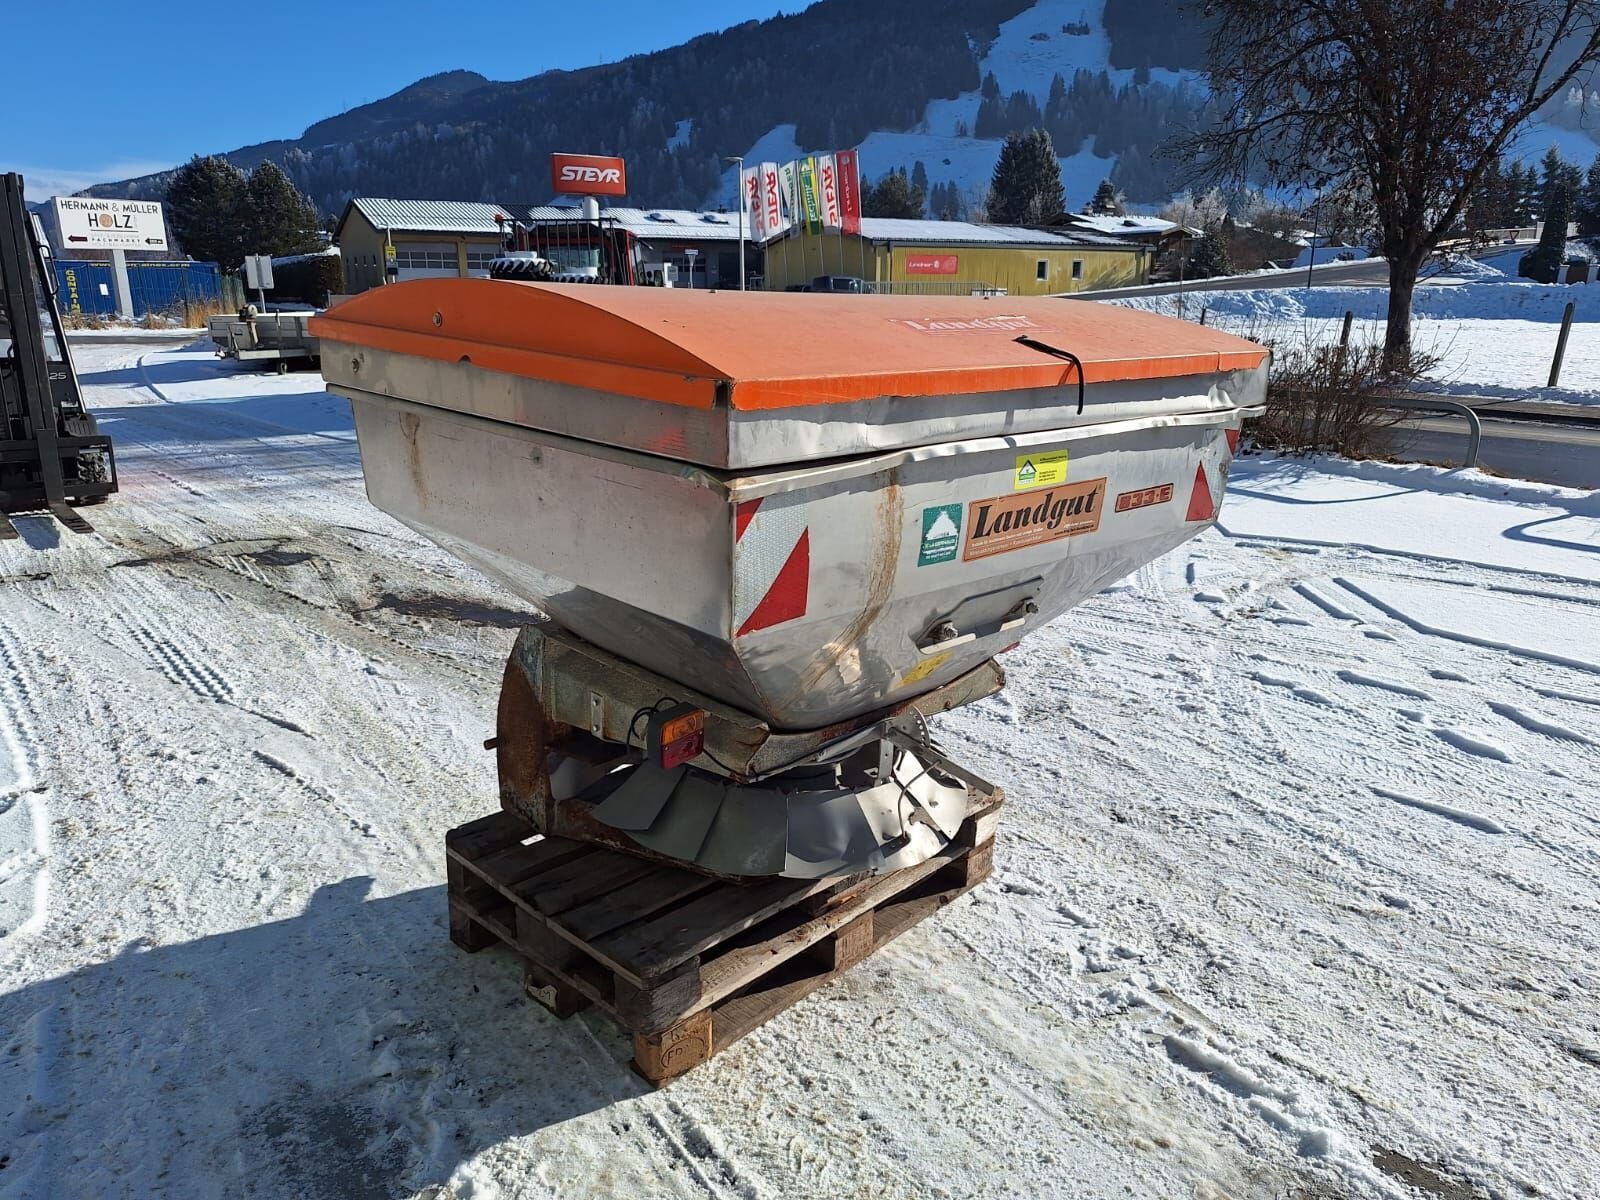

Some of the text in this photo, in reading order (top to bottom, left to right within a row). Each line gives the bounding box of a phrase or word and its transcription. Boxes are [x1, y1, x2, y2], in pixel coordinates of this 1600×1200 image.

[560, 166, 620, 183] STEYR
[60, 200, 158, 214] HERMANN & MÜLLER
[87, 213, 133, 228] HOLZ
[49, 372, 67, 380] 25
[971, 485, 1099, 539] Landgut
